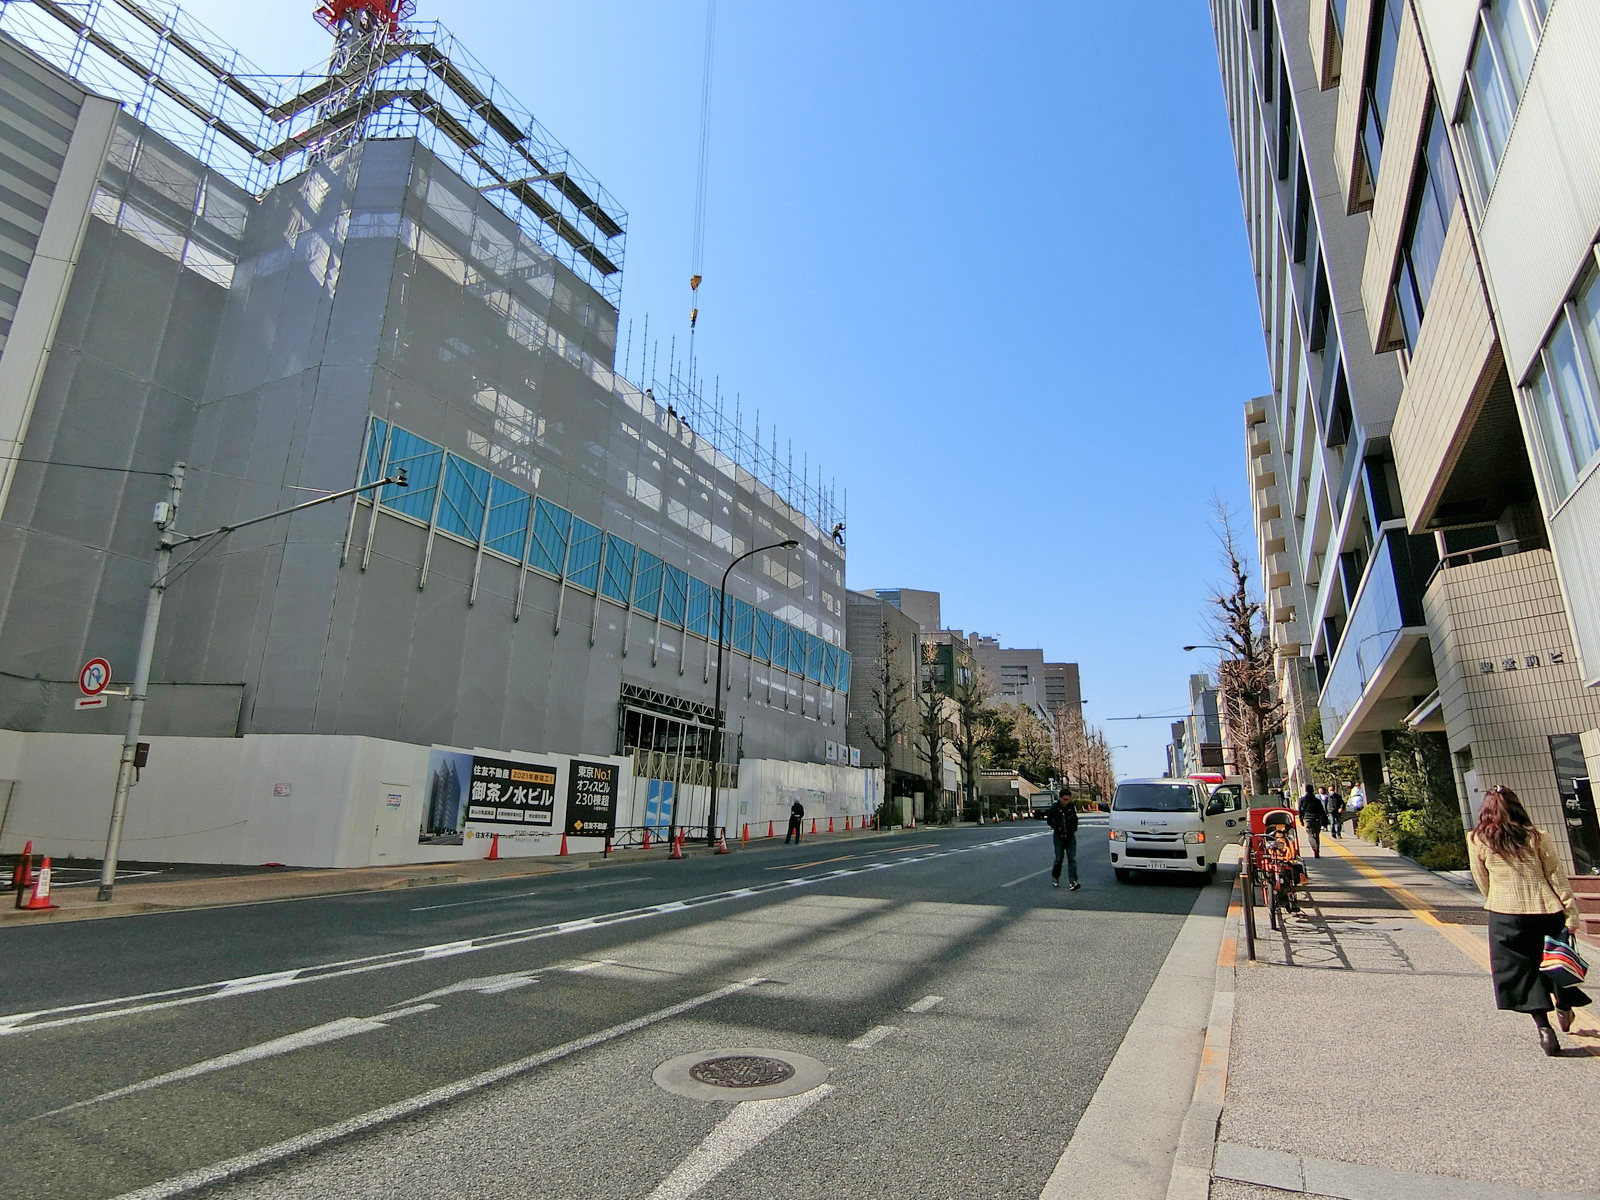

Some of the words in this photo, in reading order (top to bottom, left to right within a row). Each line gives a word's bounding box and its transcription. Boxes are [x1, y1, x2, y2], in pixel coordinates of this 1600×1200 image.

[1479, 651, 1577, 673] 聖堂前ビ
[473, 765, 510, 779] 住友不動産
[472, 781, 553, 806] 御茶ノ水ビル
[576, 779, 611, 793] オフィスビル
[575, 792, 610, 807] 230棟超
